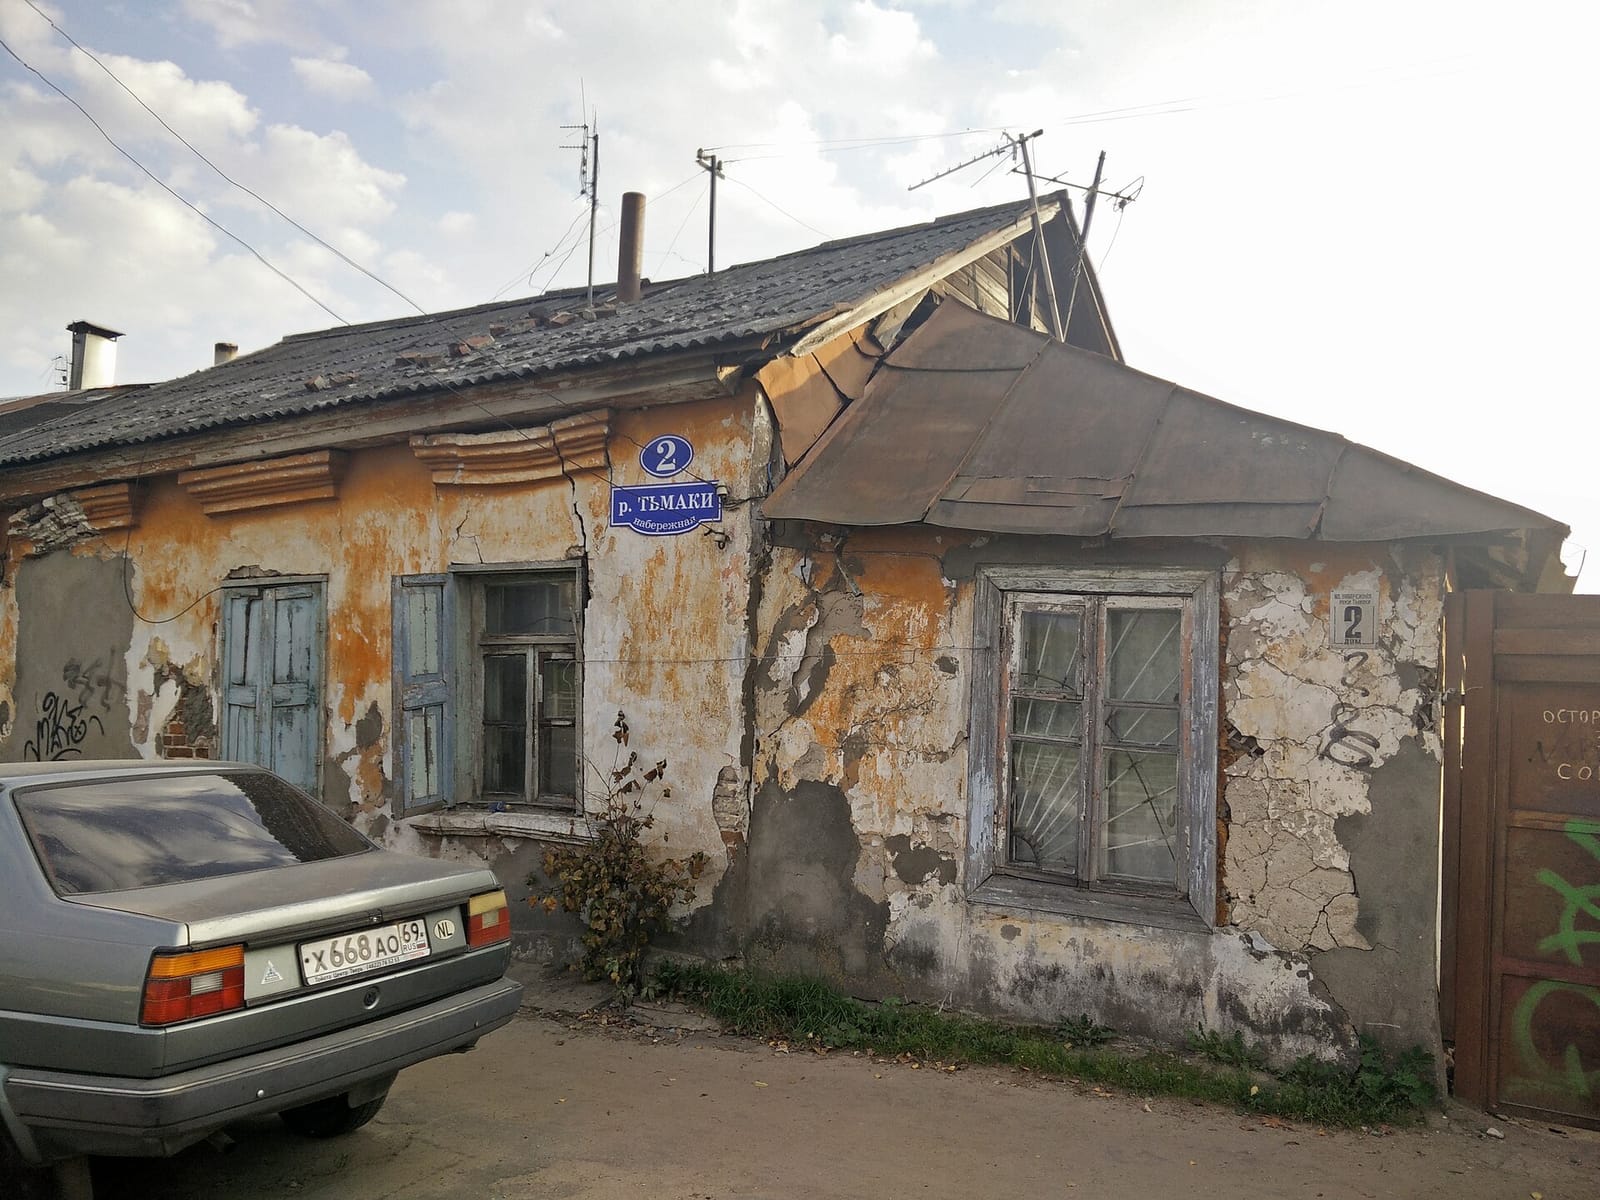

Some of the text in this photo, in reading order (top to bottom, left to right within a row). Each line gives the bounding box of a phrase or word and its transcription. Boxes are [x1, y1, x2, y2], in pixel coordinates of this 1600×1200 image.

[656, 440, 676, 471] 2
[619, 492, 714, 516] р. ТЬМАКИ
[633, 515, 697, 532] набережная
[1344, 606, 1362, 638] 2
[402, 922, 419, 943] 69
[437, 921, 453, 938] NL
[402, 944, 417, 952] RUS
